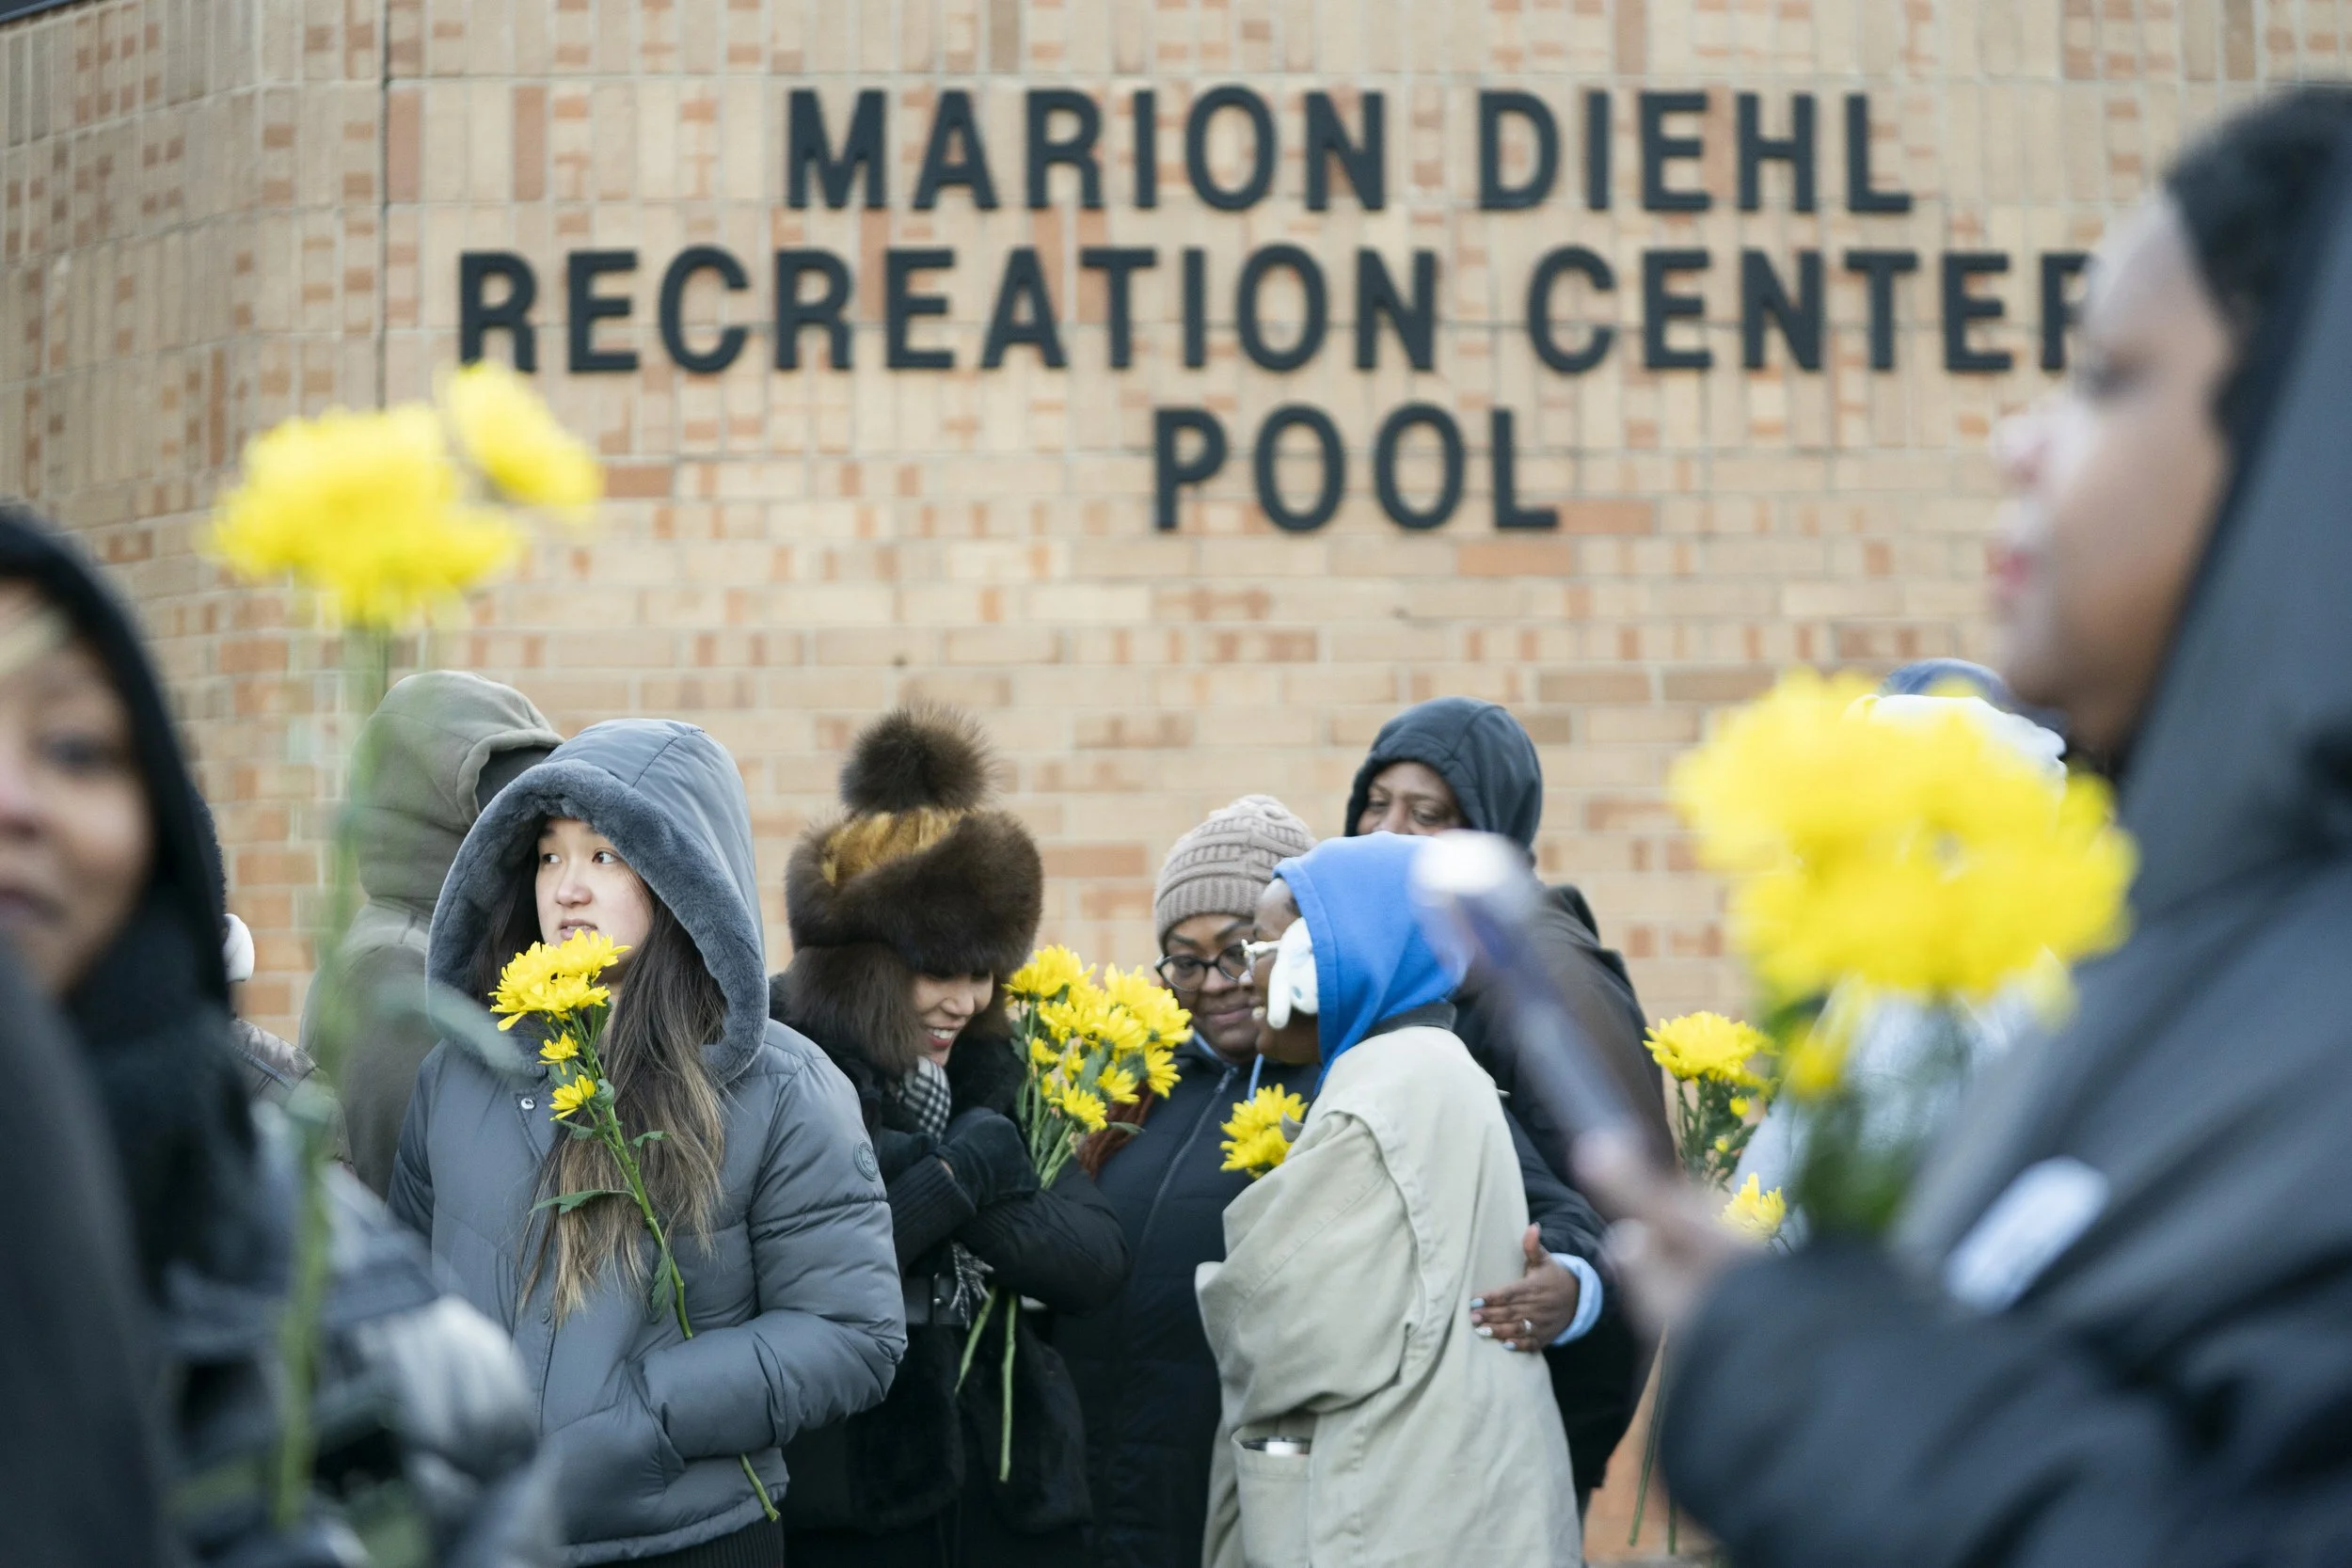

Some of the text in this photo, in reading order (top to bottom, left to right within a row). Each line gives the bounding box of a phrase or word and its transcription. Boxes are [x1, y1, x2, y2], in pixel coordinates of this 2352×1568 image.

[785, 86, 1915, 217] MARION DIEHL
[458, 244, 1440, 376] RECREATION
[1150, 403, 1560, 534] POOL
